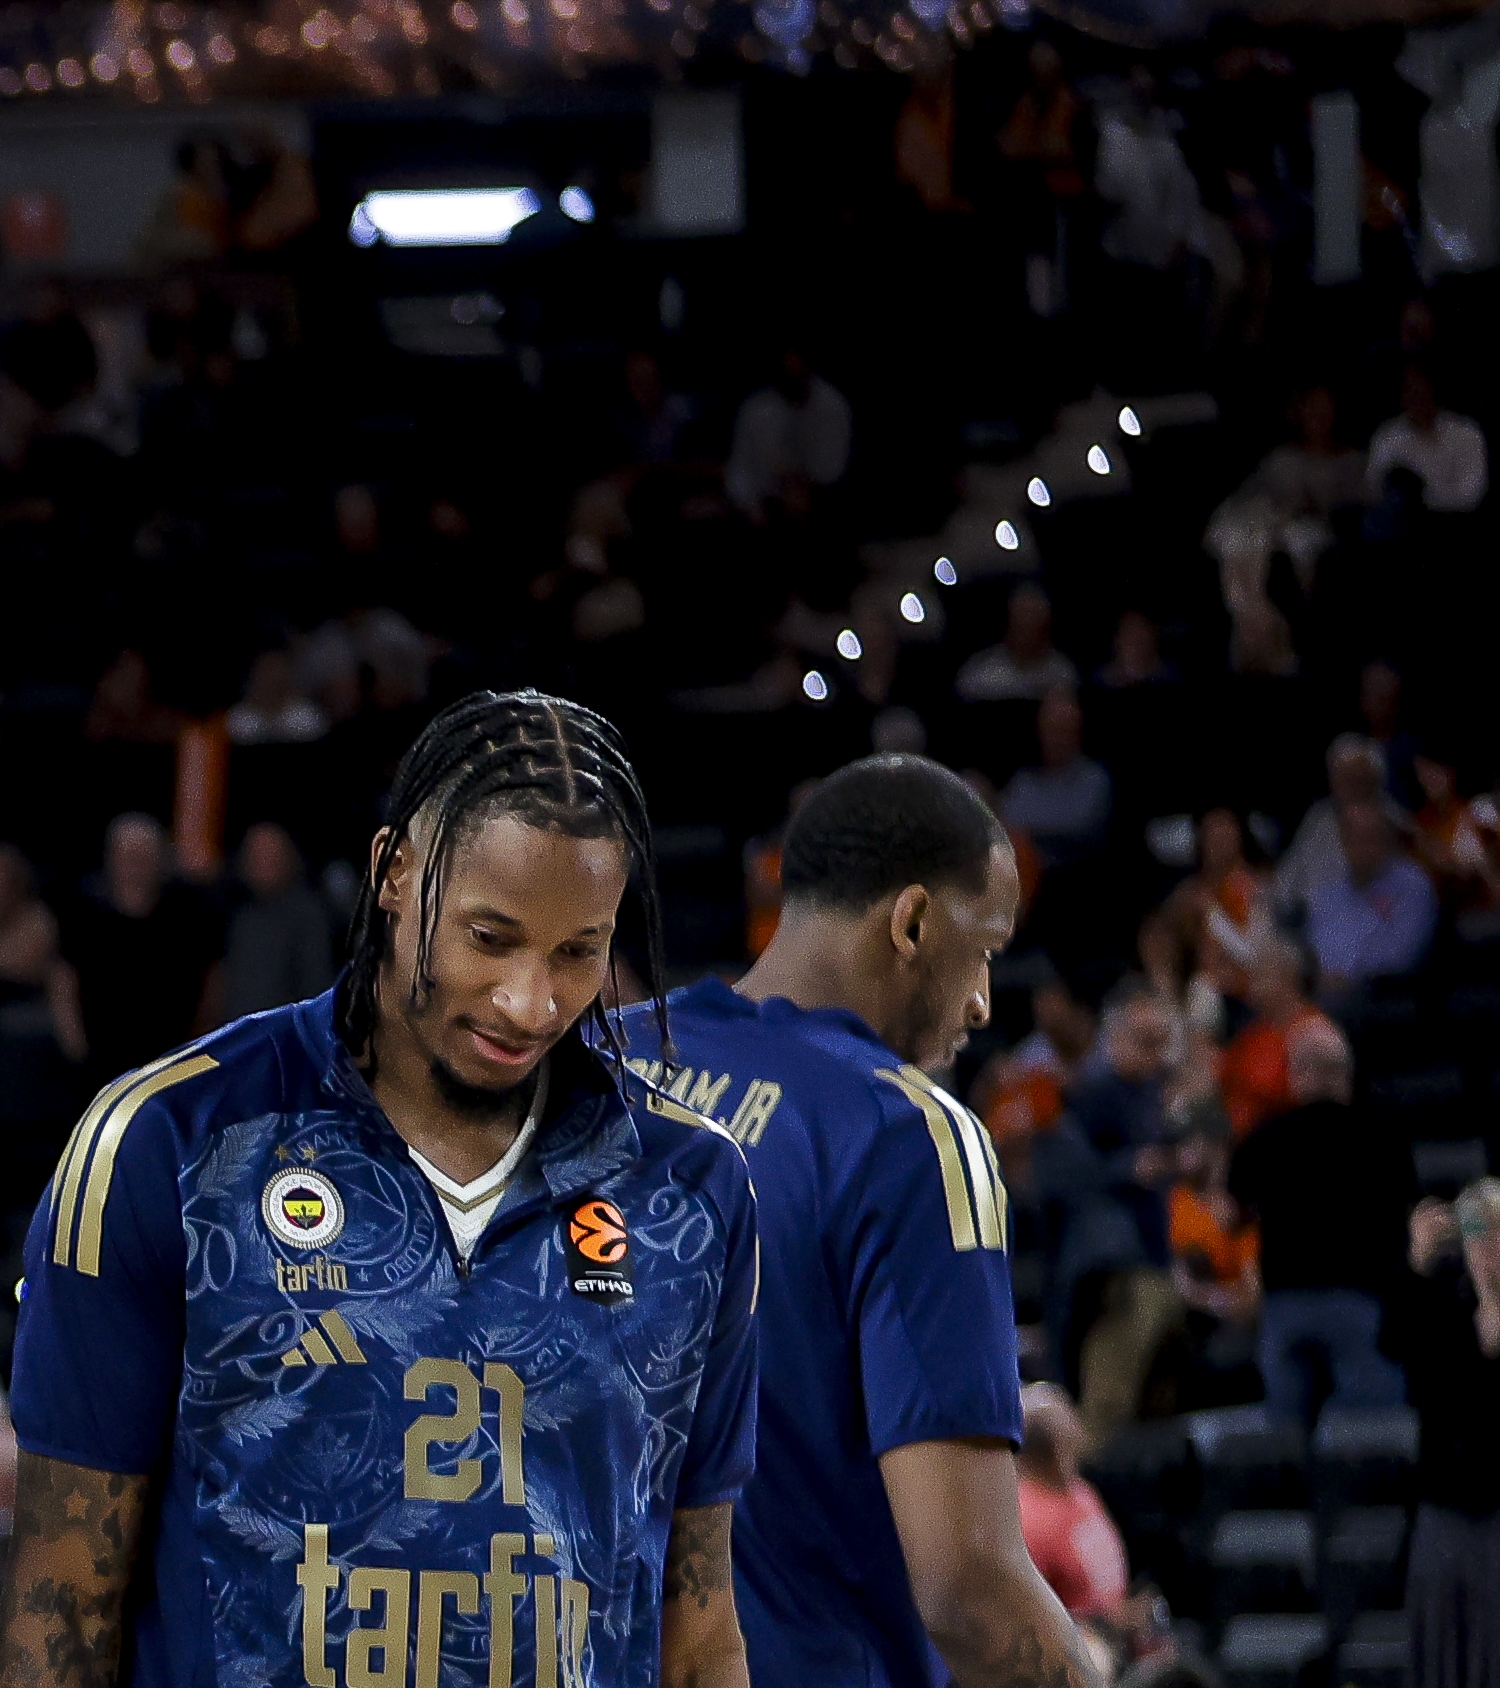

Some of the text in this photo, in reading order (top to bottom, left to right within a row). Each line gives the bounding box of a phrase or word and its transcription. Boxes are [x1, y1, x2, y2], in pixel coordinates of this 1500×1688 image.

[275, 1255, 349, 1293] tarfin
[575, 1278, 633, 1296] ETIHAD
[402, 1358, 526, 1507] 21
